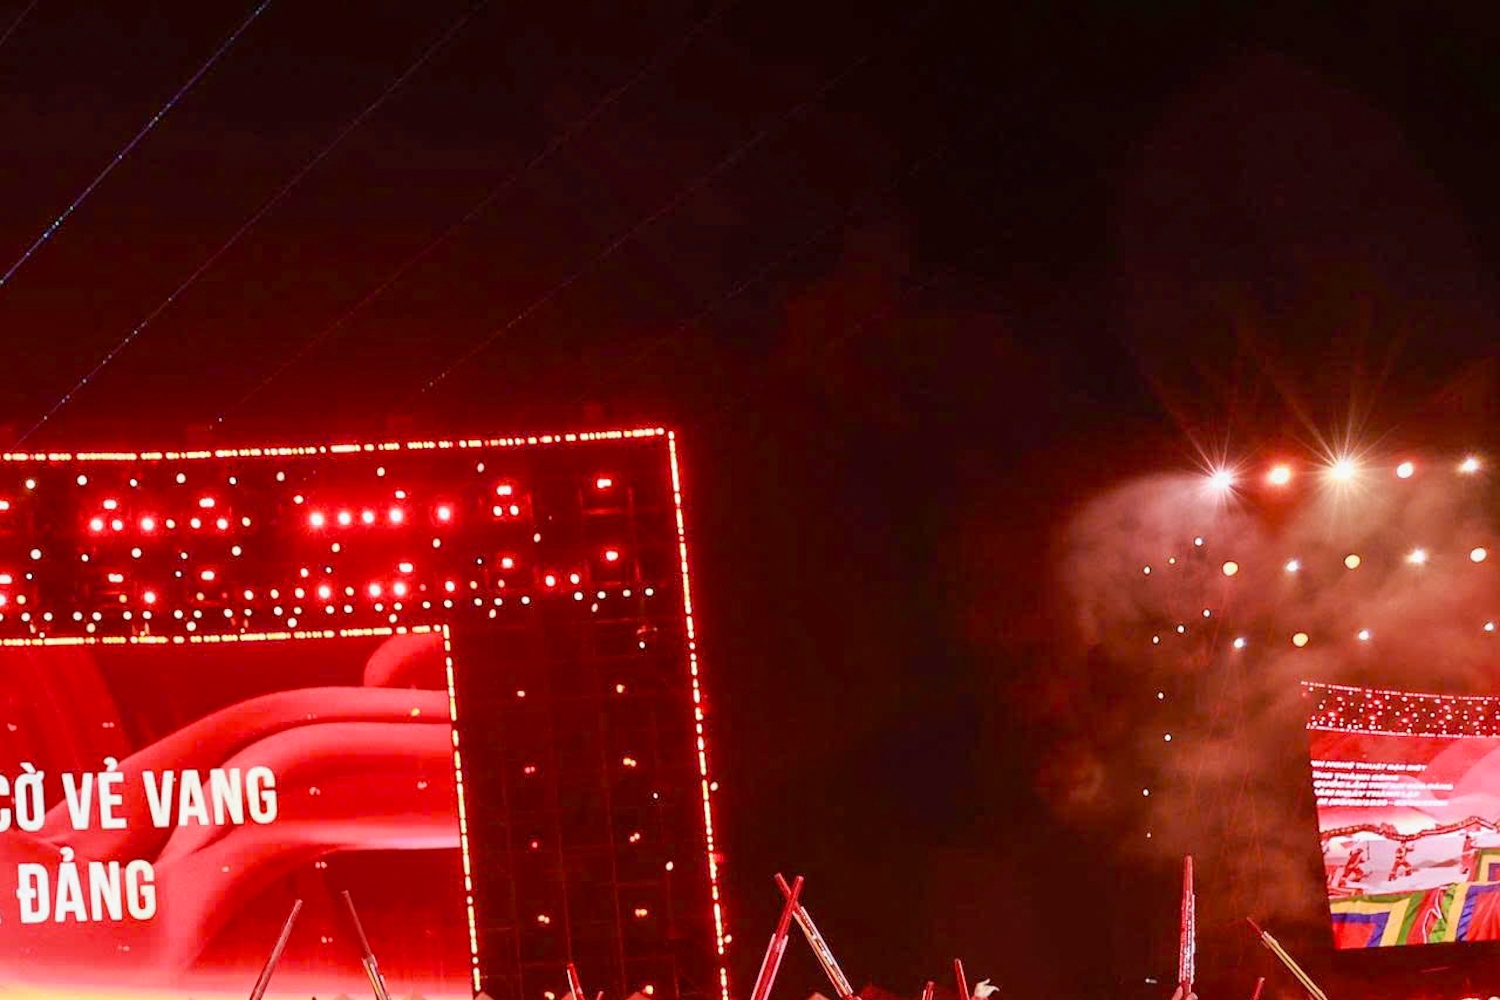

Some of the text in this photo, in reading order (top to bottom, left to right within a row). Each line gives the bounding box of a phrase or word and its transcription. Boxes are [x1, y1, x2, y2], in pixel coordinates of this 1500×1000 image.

[61, 757, 127, 830] VẺ
[142, 765, 278, 828] VANG
[15, 846, 156, 924] ĐẢNG
